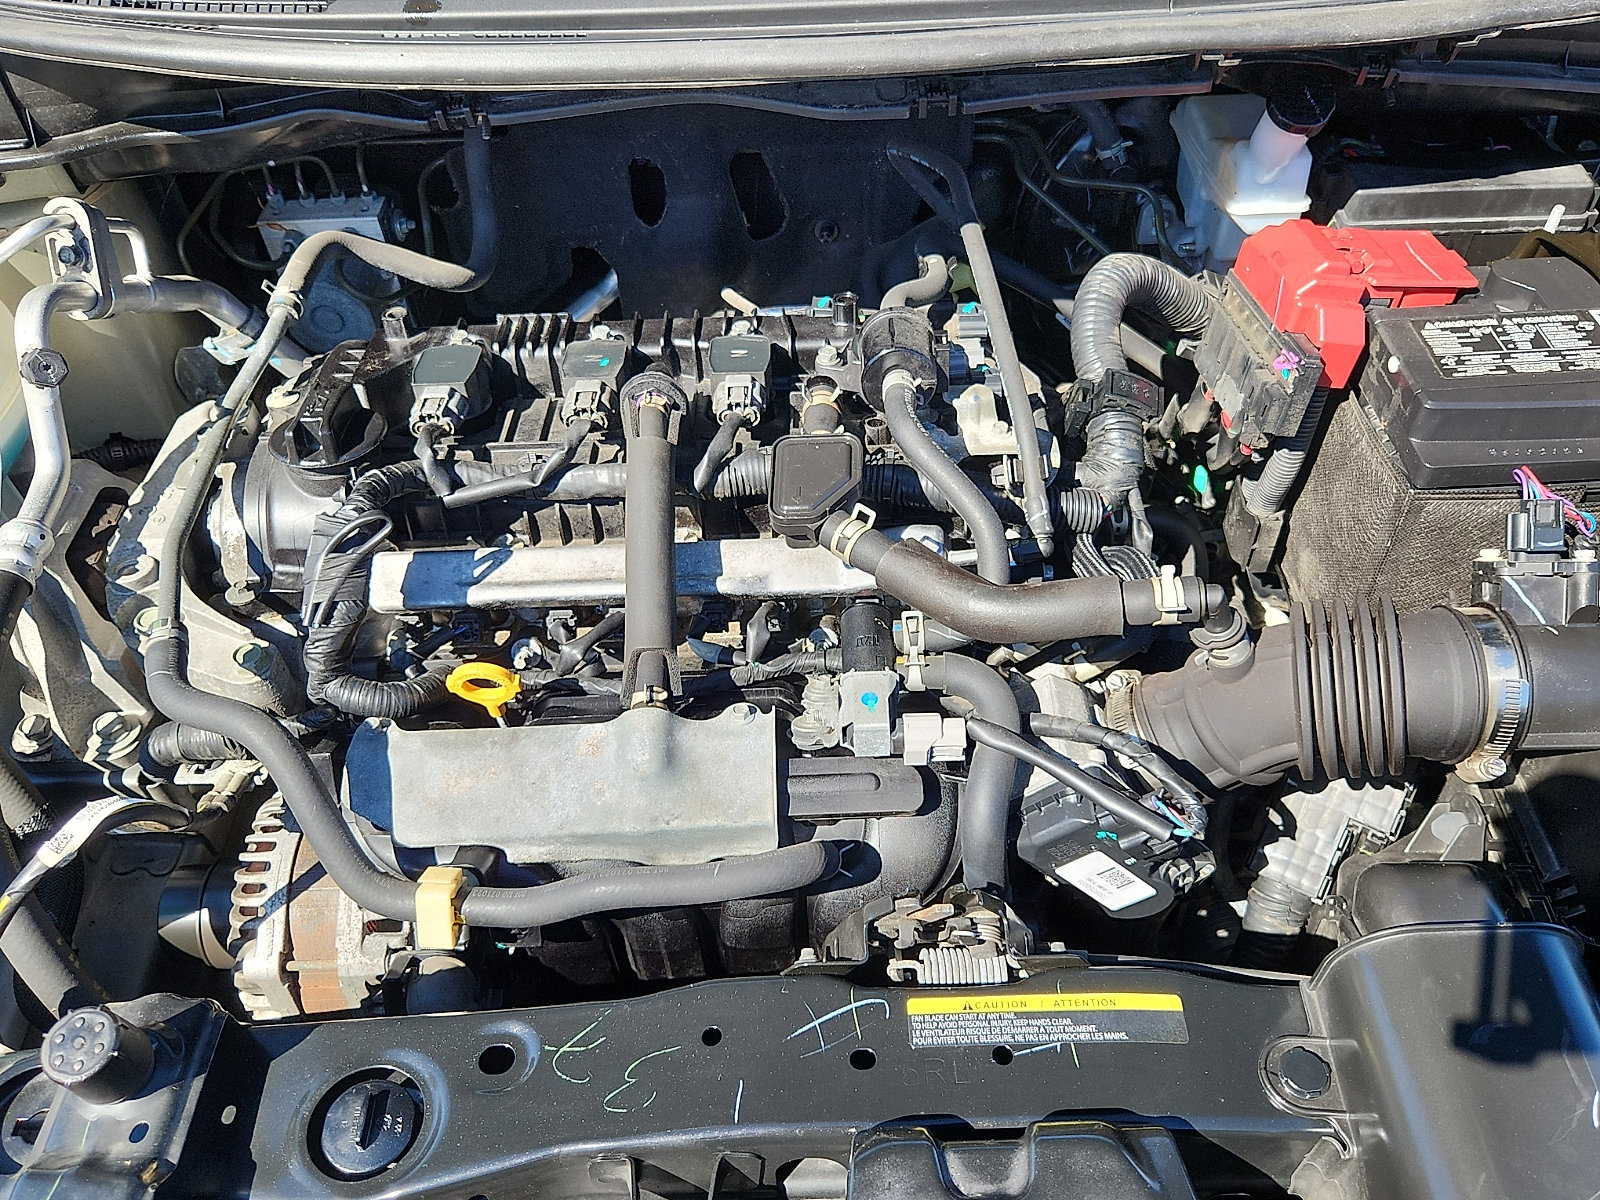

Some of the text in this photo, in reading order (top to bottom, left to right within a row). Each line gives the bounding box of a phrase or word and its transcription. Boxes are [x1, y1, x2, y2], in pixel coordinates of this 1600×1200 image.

[975, 1000, 1027, 1010] CAUTION
[1053, 998, 1117, 1008] ATTENTION
[911, 1011, 1017, 1022] FAN BLADE CAN START AT ANY TIME.
[912, 1022, 921, 1030] TO
[922, 1021, 937, 1030] HELP
[938, 1021, 957, 1029] AVOID
[958, 1019, 990, 1028] PERSONAL
[1013, 1018, 1028, 1027] KEEP
[1029, 1018, 1051, 1026] HANDS
[1052, 1017, 1073, 1025] CLEAR.
[912, 1029, 921, 1038] LE
[921, 1028, 965, 1037] VENTILATEUR
[966, 1026, 991, 1036] RISQUE
[991, 1026, 1001, 1035] DE
[1002, 1025, 1039, 1034] DÉMARRER
[1046, 1024, 1064, 1033] TOUT
[1065, 1024, 1099, 1033] MOMENT.
[912, 1036, 932, 1046] POUR
[933, 1035, 956, 1046] ÉVITER
[956, 1035, 978, 1045] TOUTE
[1015, 1033, 1025, 1042] NE
[1025, 1033, 1038, 1042] PAS
[1039, 1033, 1048, 1042] EN
[1049, 1032, 1091, 1042] APPROCHER
[1091, 1032, 1103, 1040] LES
[1104, 1031, 1129, 1040] MAINS.
